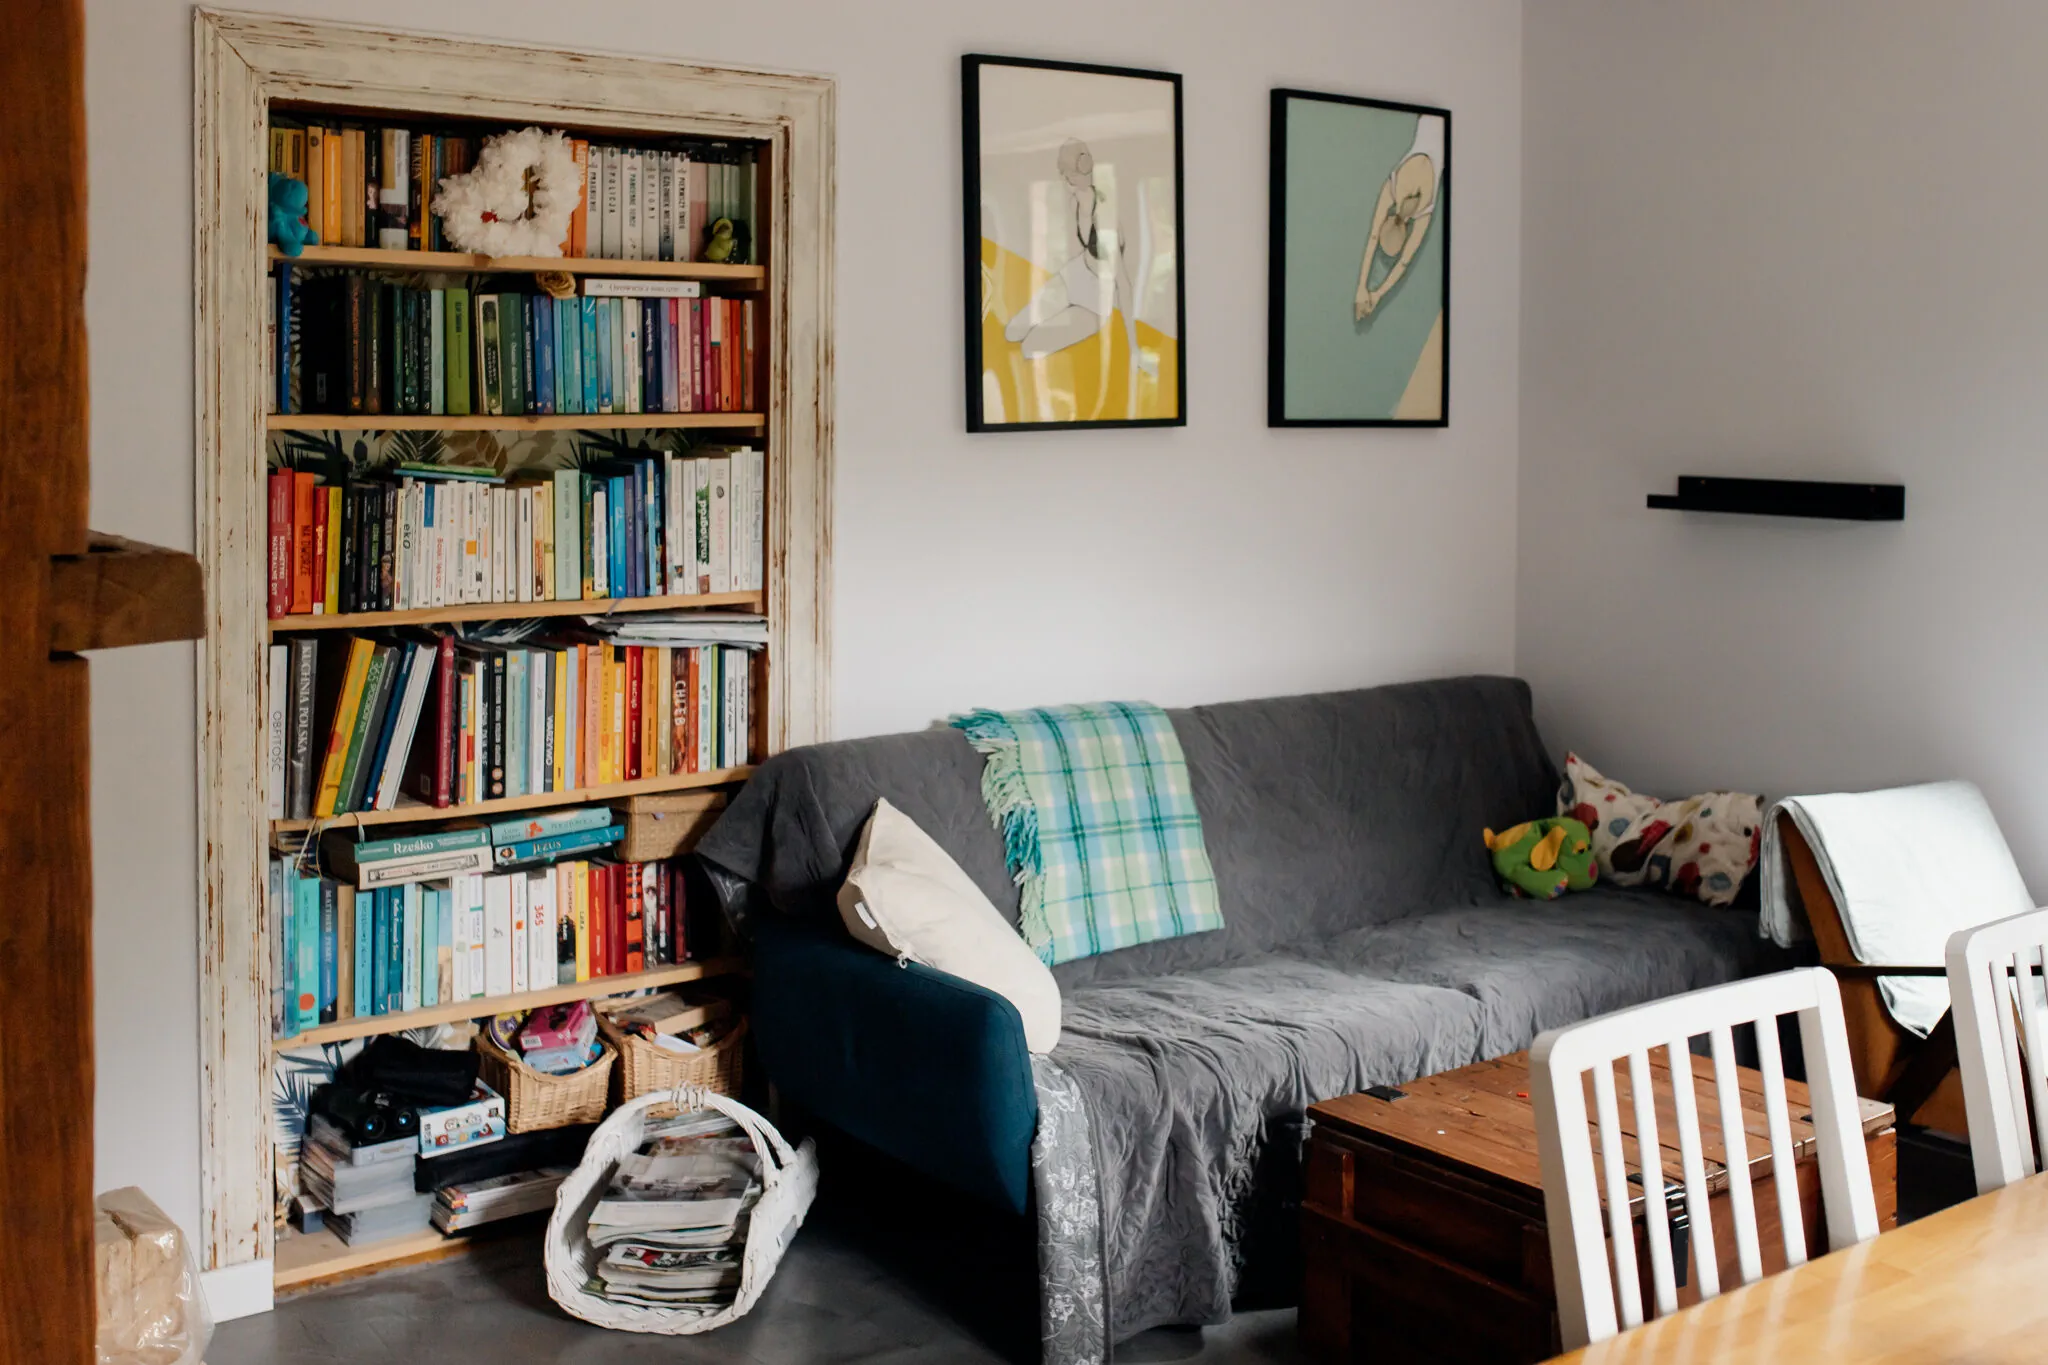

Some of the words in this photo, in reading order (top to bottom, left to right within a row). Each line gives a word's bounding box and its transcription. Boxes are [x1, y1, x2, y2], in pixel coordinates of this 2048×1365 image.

[608, 171, 616, 215] POLICJA
[299, 645, 312, 705] KUCHNIA
[367, 661, 383, 683] 365
[361, 682, 378, 722] SPOSOBÓW
[674, 680, 687, 726] CHLEB
[271, 710, 282, 773] OBFITOŚĆ
[297, 706, 309, 755] POLSKA
[545, 715, 554, 766] WARZYWO
[532, 839, 562, 854] JEZUS
[534, 904, 545, 927] 365
